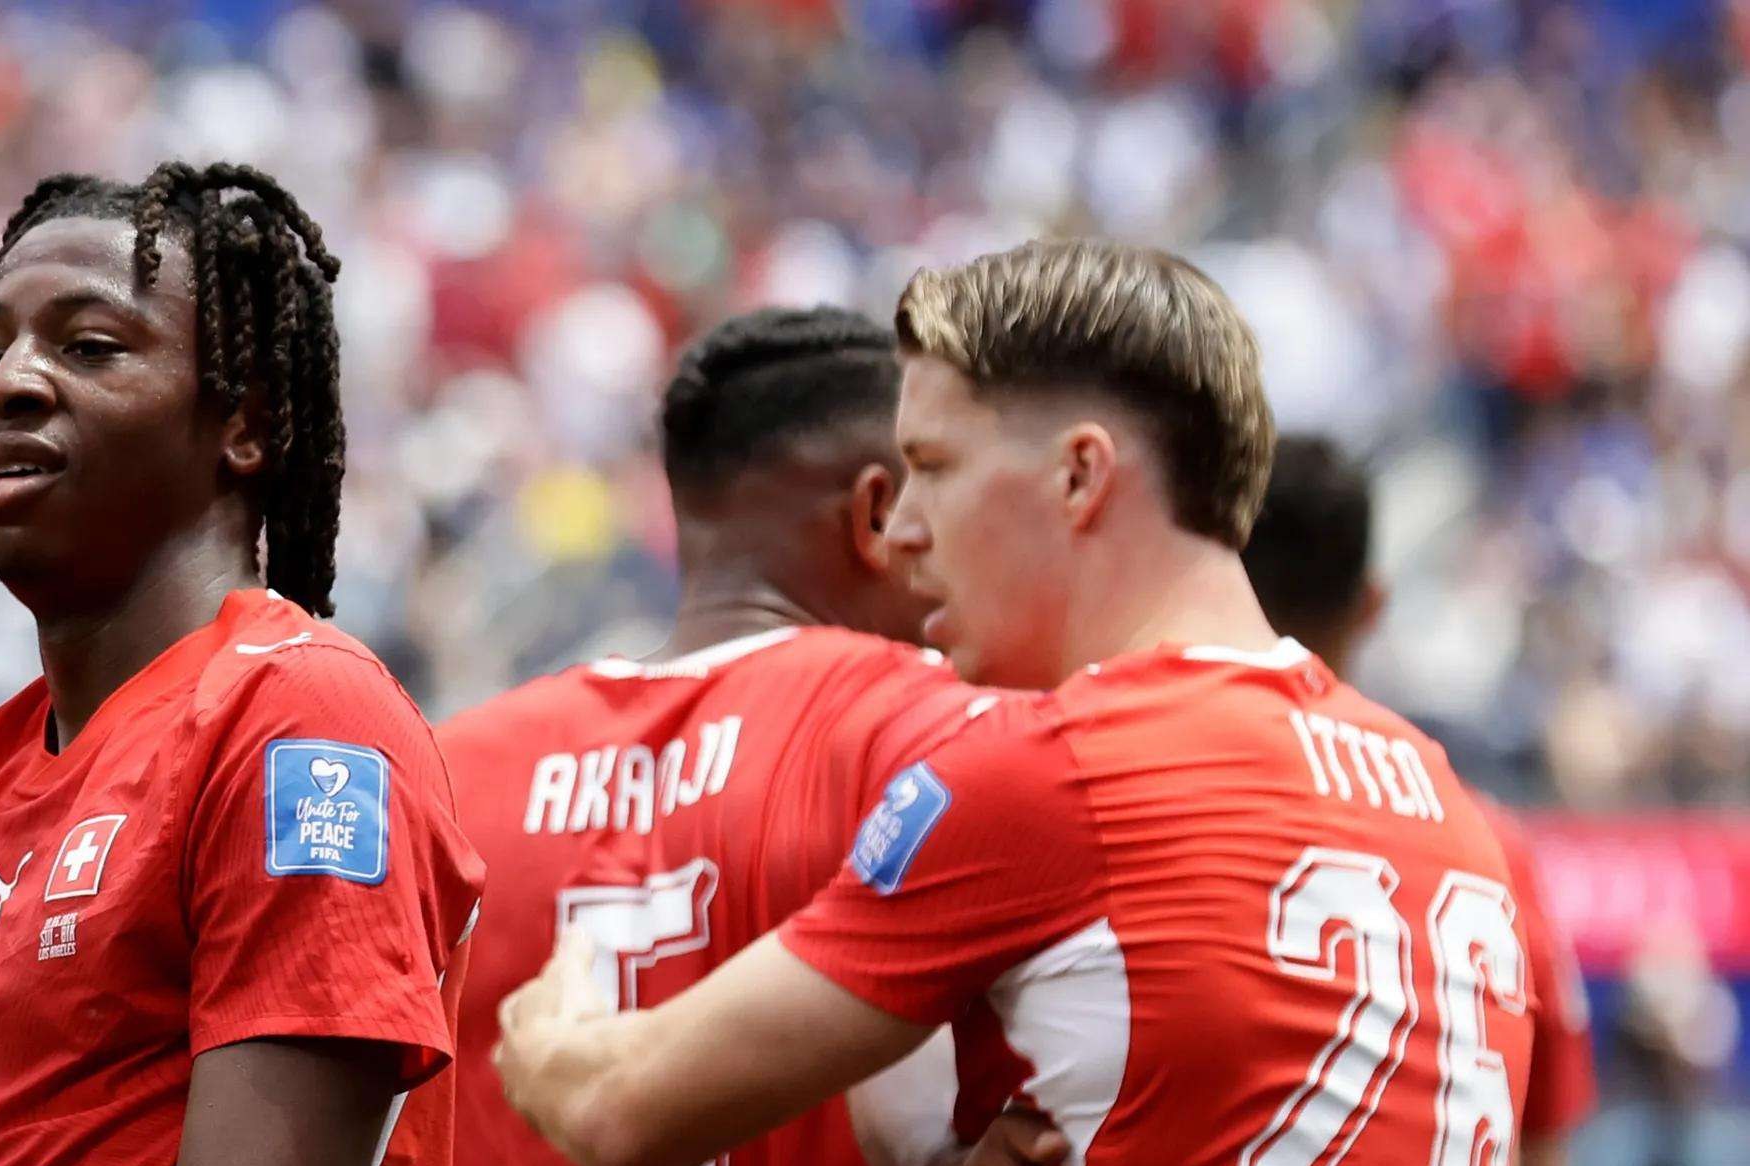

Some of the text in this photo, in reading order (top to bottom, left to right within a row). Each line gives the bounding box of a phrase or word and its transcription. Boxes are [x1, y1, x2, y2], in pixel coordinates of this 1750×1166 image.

[523, 714, 743, 835] AKANJI
[1289, 709, 1445, 824] ITTEN
[299, 821, 355, 849] PEACE
[310, 846, 342, 862] FIFA
